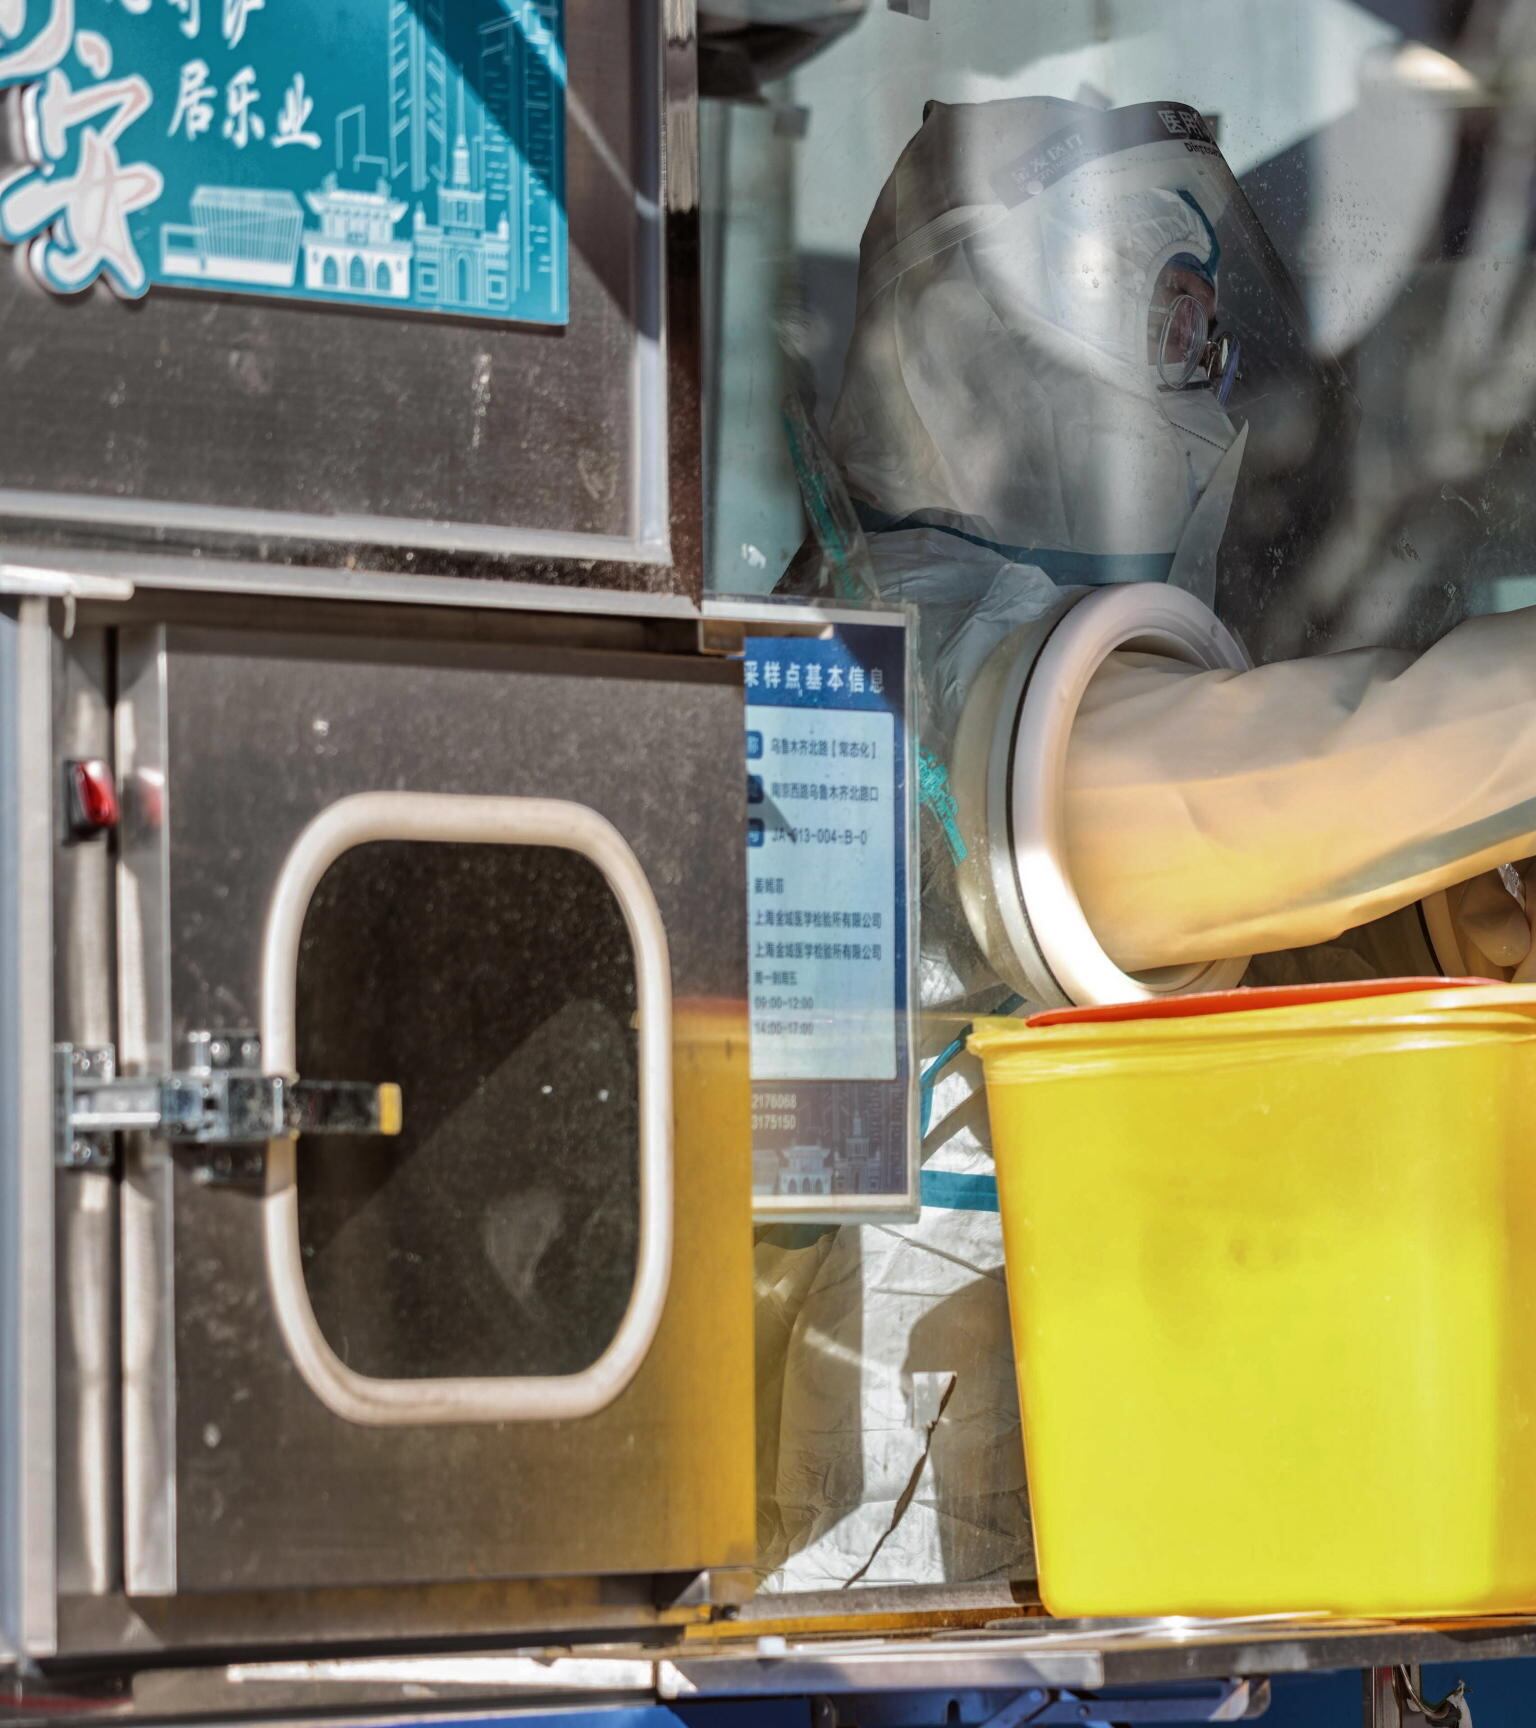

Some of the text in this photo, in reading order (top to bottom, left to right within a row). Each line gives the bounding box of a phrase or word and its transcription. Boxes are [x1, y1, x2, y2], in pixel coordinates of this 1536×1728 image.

[167, 58, 322, 149] 居乐业
[744, 660, 885, 694] 采样点基本信息
